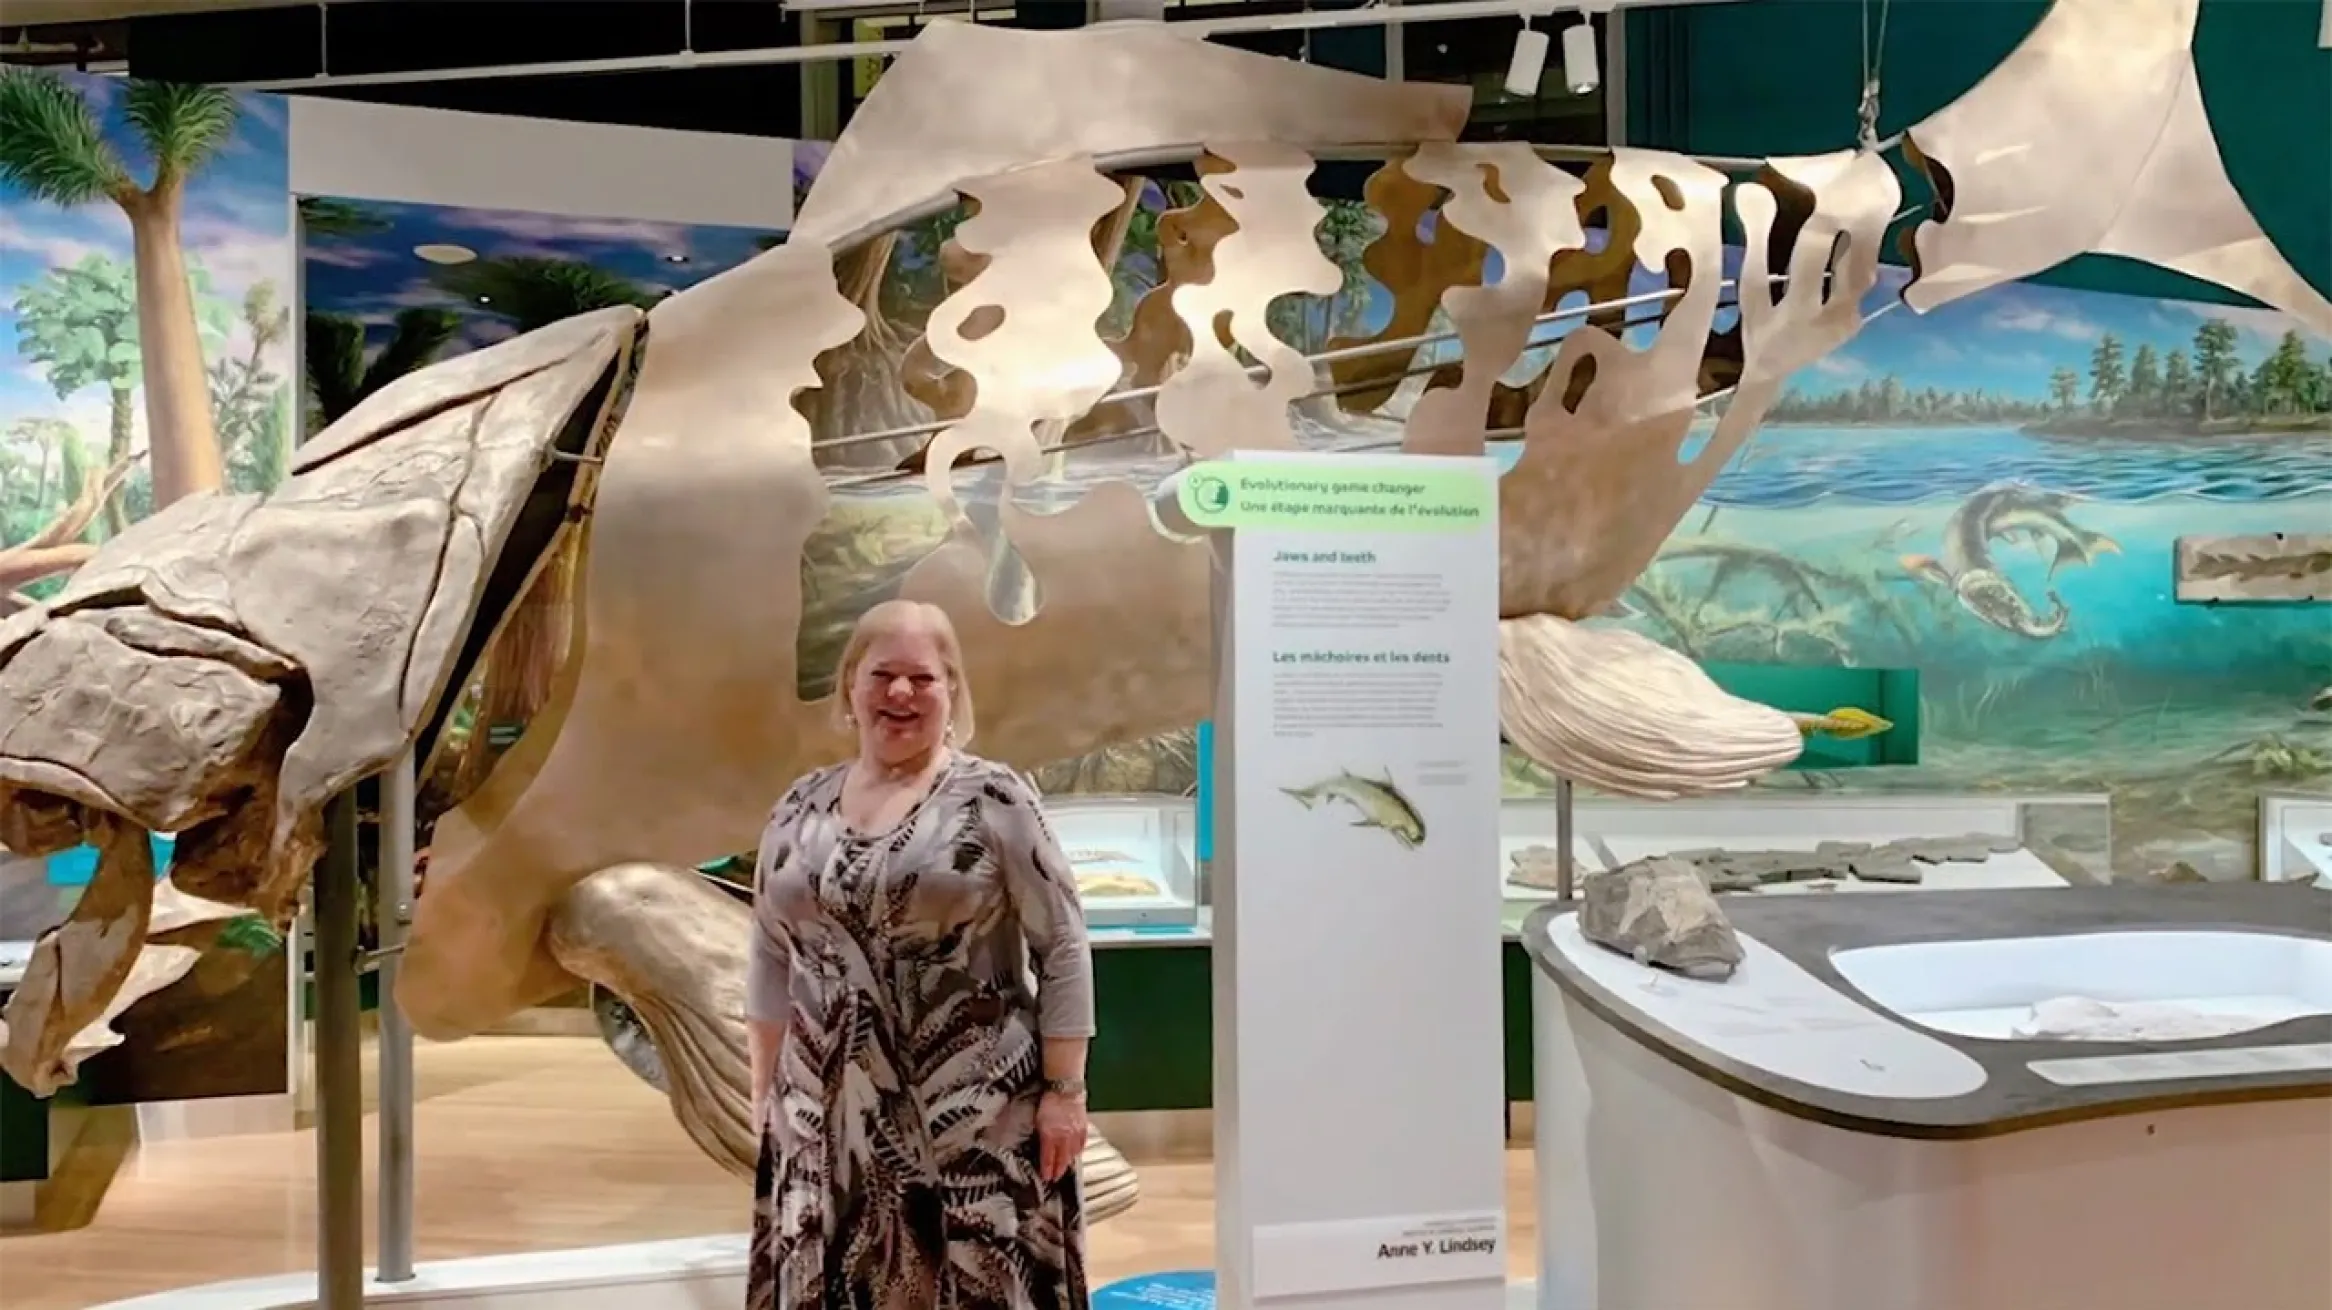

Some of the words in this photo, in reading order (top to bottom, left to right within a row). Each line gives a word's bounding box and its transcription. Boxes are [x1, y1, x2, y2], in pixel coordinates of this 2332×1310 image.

[1240, 477, 1329, 494] Evolutionary
[1332, 482, 1369, 495] game
[1372, 481, 1426, 497] changer
[1240, 501, 1267, 514] Une
[1271, 500, 1309, 516] étape
[1313, 501, 1387, 517] marquante
[1389, 503, 1405, 516] de
[1273, 551, 1308, 563] Jaws
[1312, 551, 1337, 563] and
[1341, 551, 1377, 564] teeth
[1273, 651, 1296, 663] Les
[1300, 650, 1370, 664] mâchoires
[1373, 652, 1387, 664] et
[1390, 651, 1409, 664] les
[1412, 651, 1450, 664] dents
[1377, 1243, 1418, 1259] Anne
[1422, 1240, 1435, 1255] Y.
[1439, 1237, 1497, 1255] Lindsey
